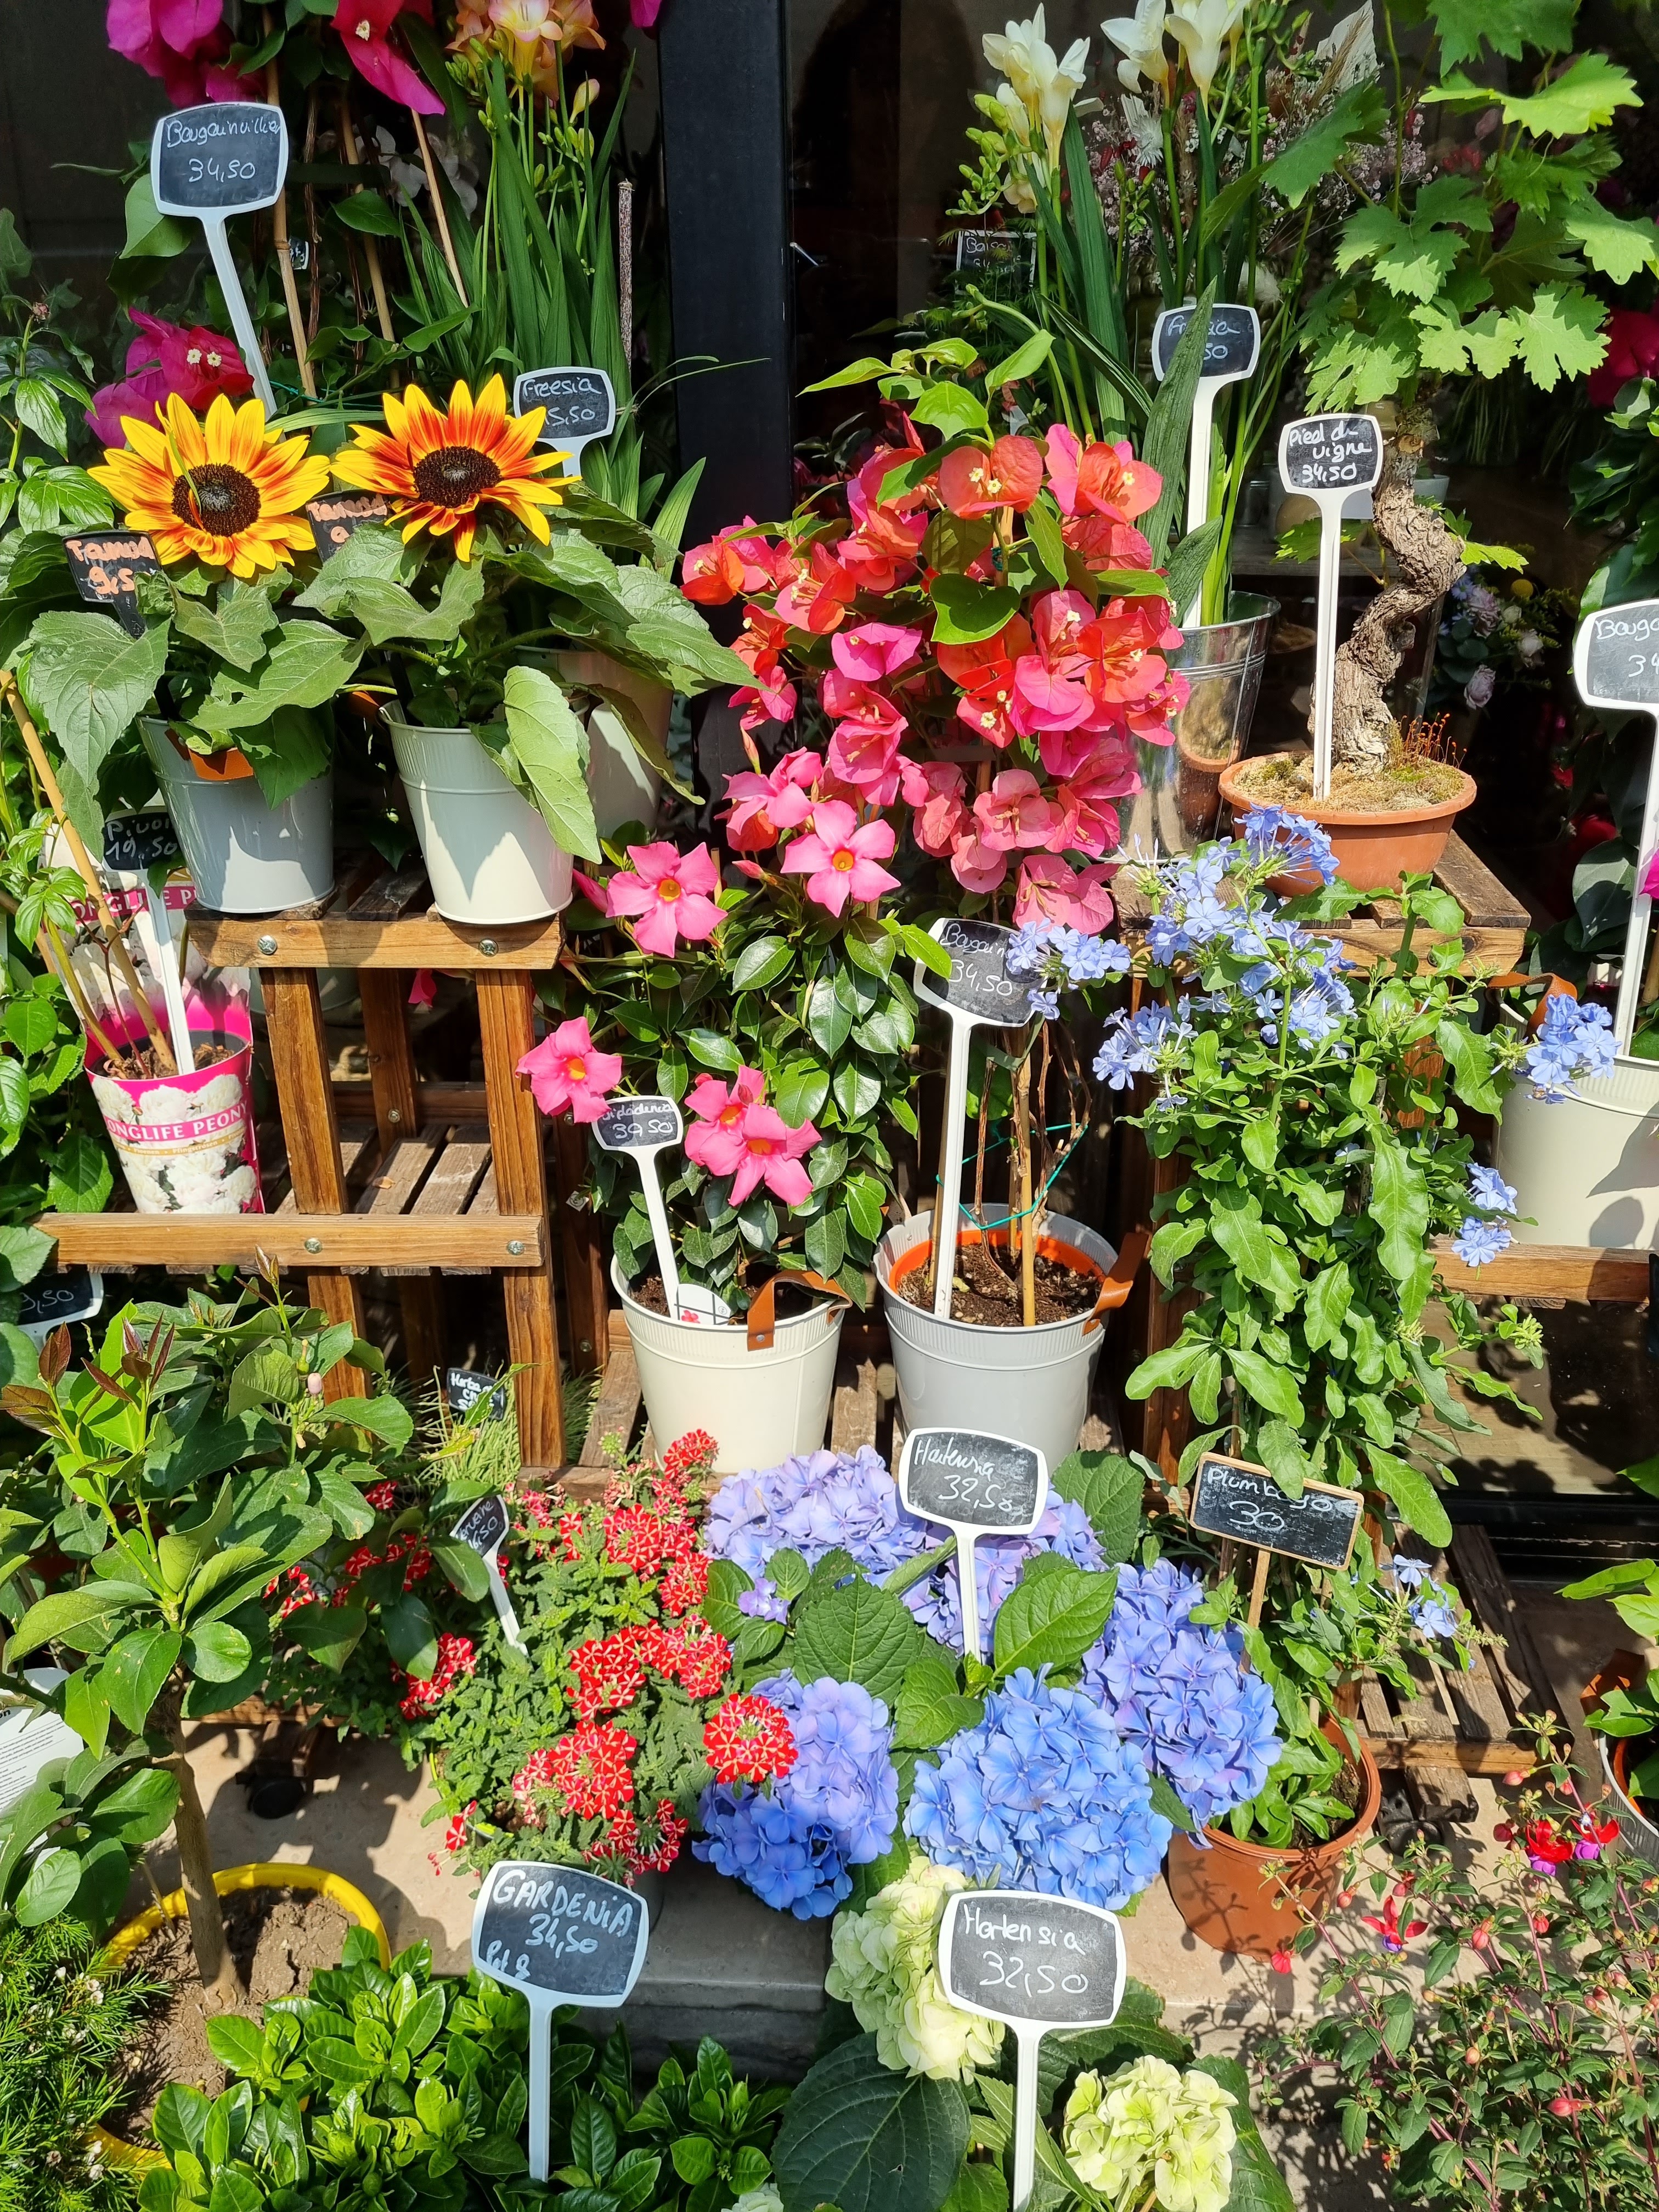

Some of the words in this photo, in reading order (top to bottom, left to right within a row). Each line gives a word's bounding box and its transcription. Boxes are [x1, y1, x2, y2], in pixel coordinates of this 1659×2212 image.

[188, 158, 256, 183] 34,50
[523, 376, 602, 397] Freesia
[1289, 422, 1325, 447] Pied
[1312, 442, 1373, 463] vigne
[1302, 462, 1357, 483] 34,50
[89, 566, 136, 595] 9,5
[939, 923, 1008, 958] Bougain
[949, 958, 1013, 996] 34,50
[106, 1119, 185, 1141] ONGLIFE
[938, 1474, 1013, 1511] 32,50
[1229, 1500, 1285, 1531] 30
[525, 1913, 599, 1959] 34,50
[978, 1950, 1089, 1998] 32,50
